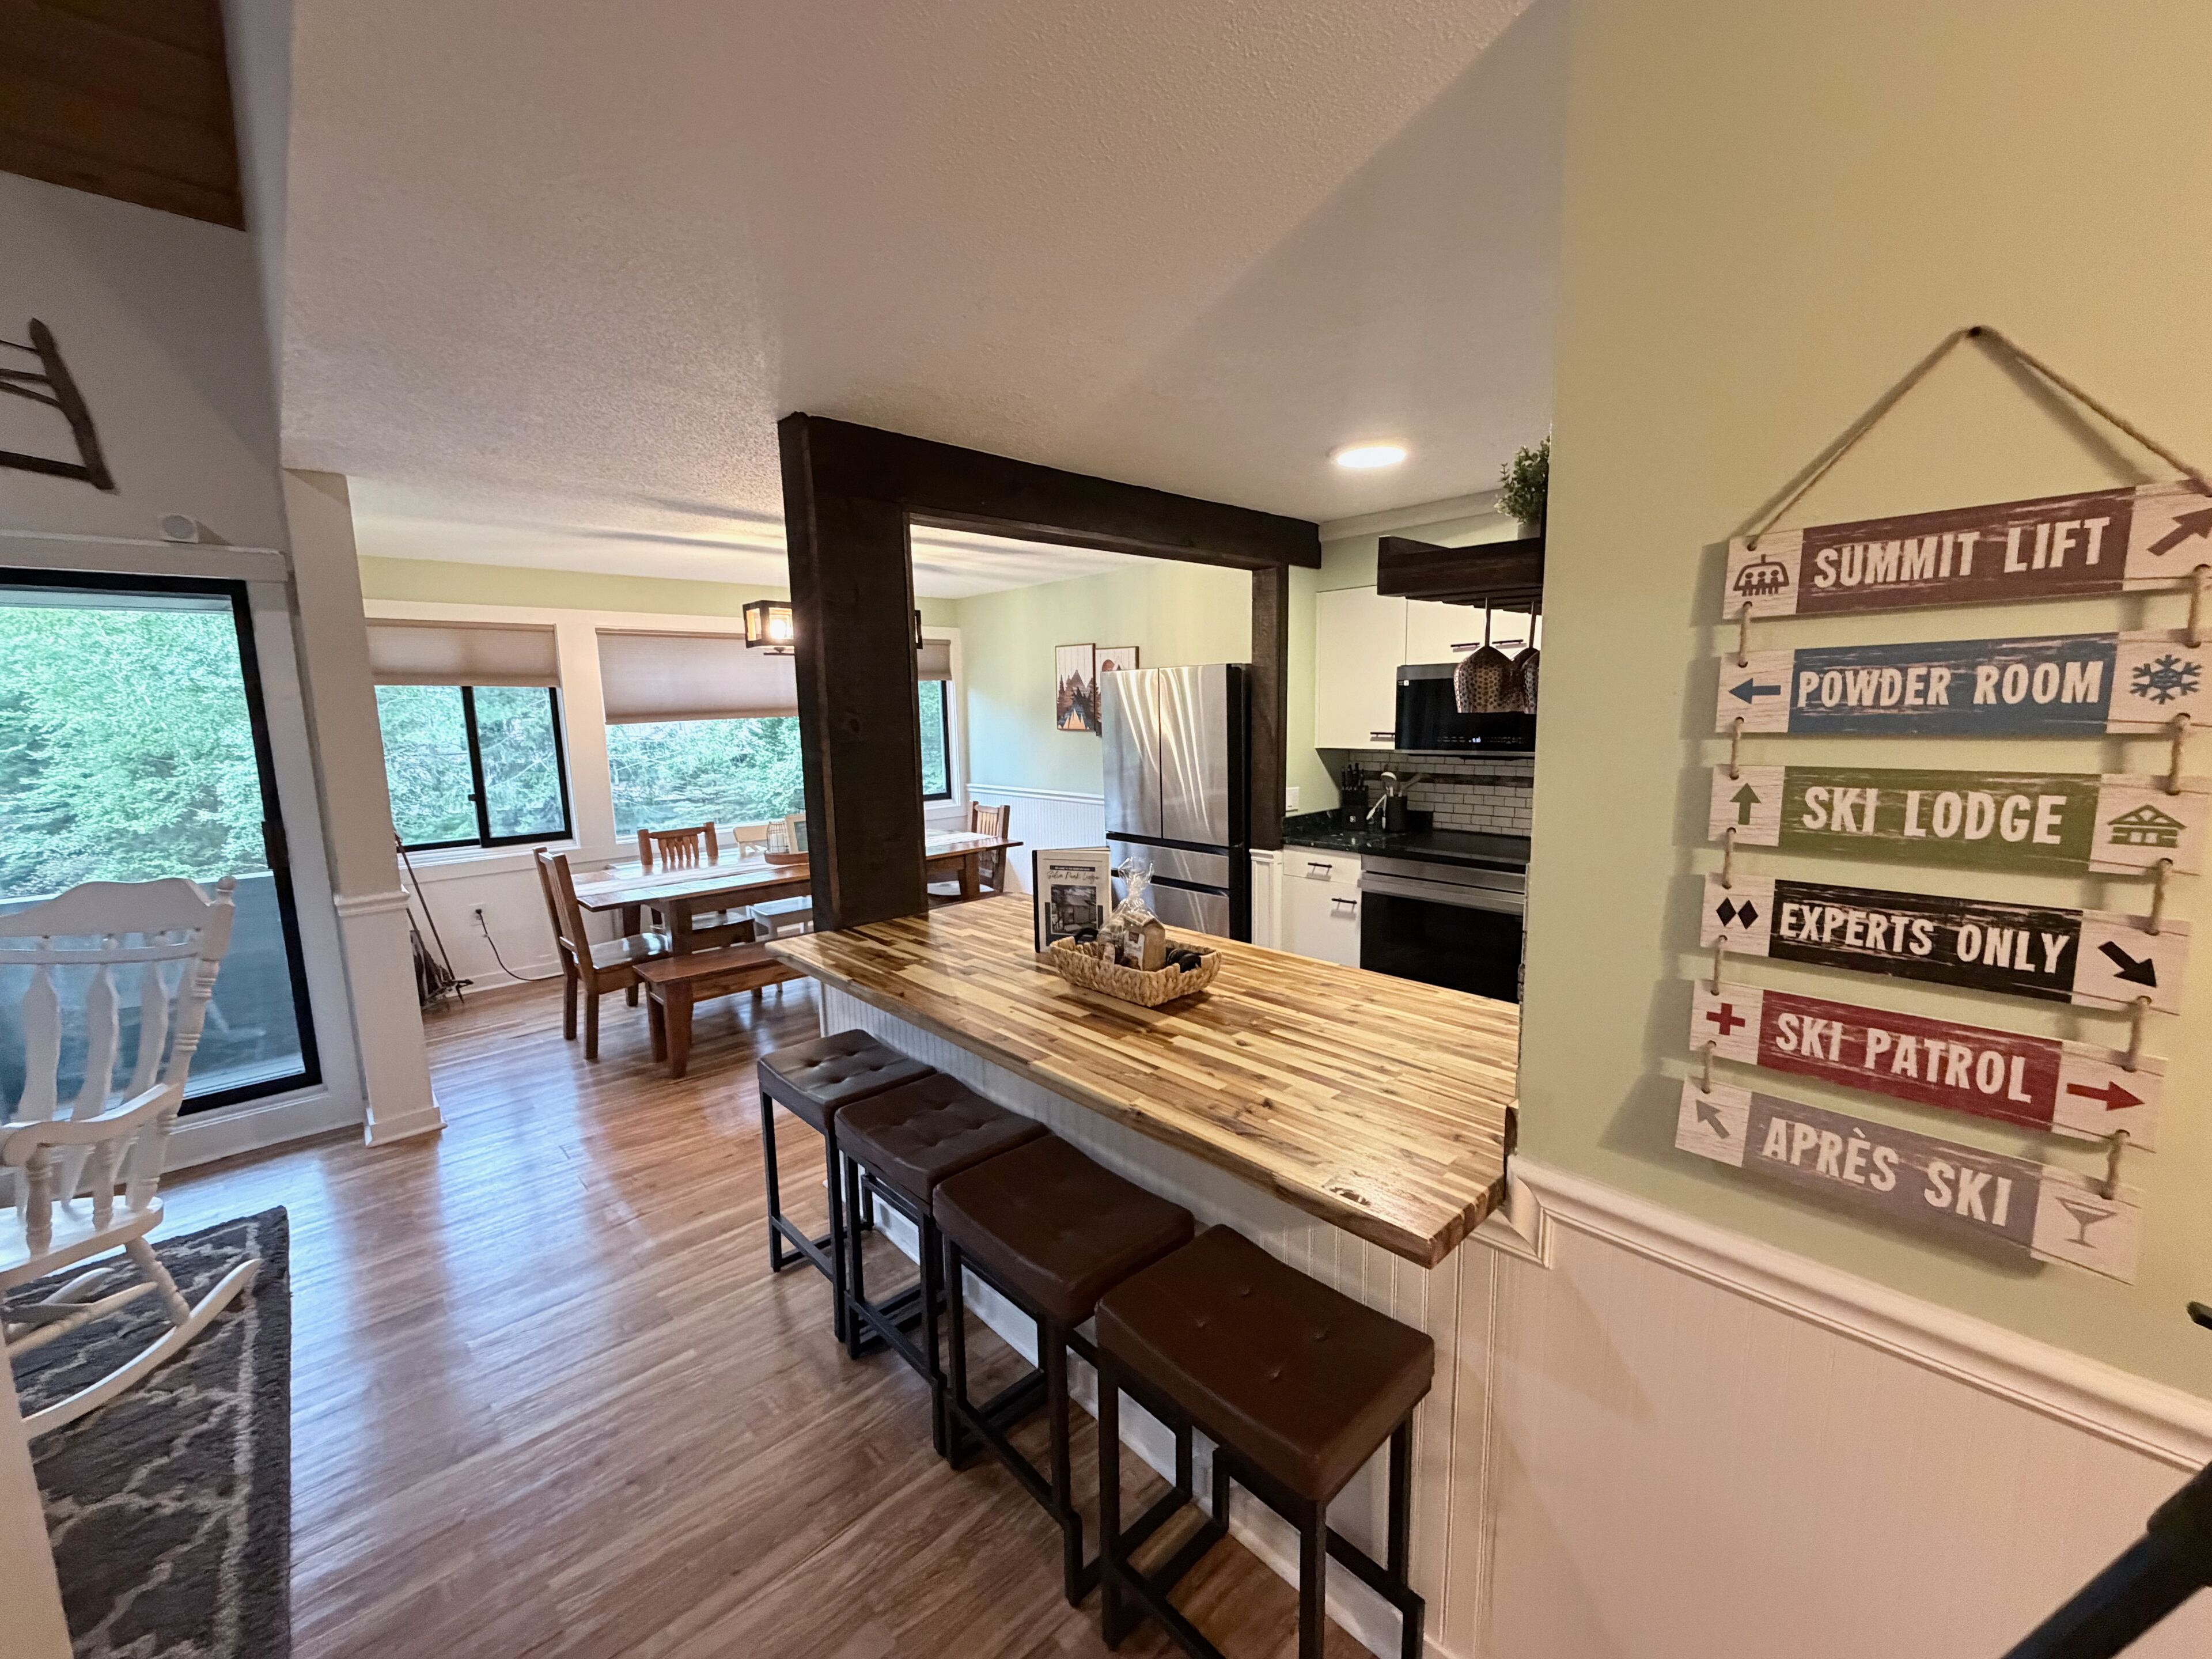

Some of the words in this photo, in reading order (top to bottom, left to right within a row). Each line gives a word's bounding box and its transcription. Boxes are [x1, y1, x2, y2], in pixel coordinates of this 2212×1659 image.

[1813, 531, 1980, 588] SUMMIT
[2004, 517, 2111, 574] LIFT
[1797, 666, 1952, 708] POWDER
[1973, 660, 2104, 704] ROOM
[1802, 786, 1878, 835] SKI
[1903, 790, 2067, 845] LODGE
[1778, 903, 1934, 956] EXPERTS
[1957, 925, 2070, 974] ONLY
[1775, 1013, 1843, 1063] SKI
[1863, 1028, 2032, 1104] PATROL
[1762, 1117, 1899, 1192] APRÈS
[1923, 1162, 2013, 1227] SKI
